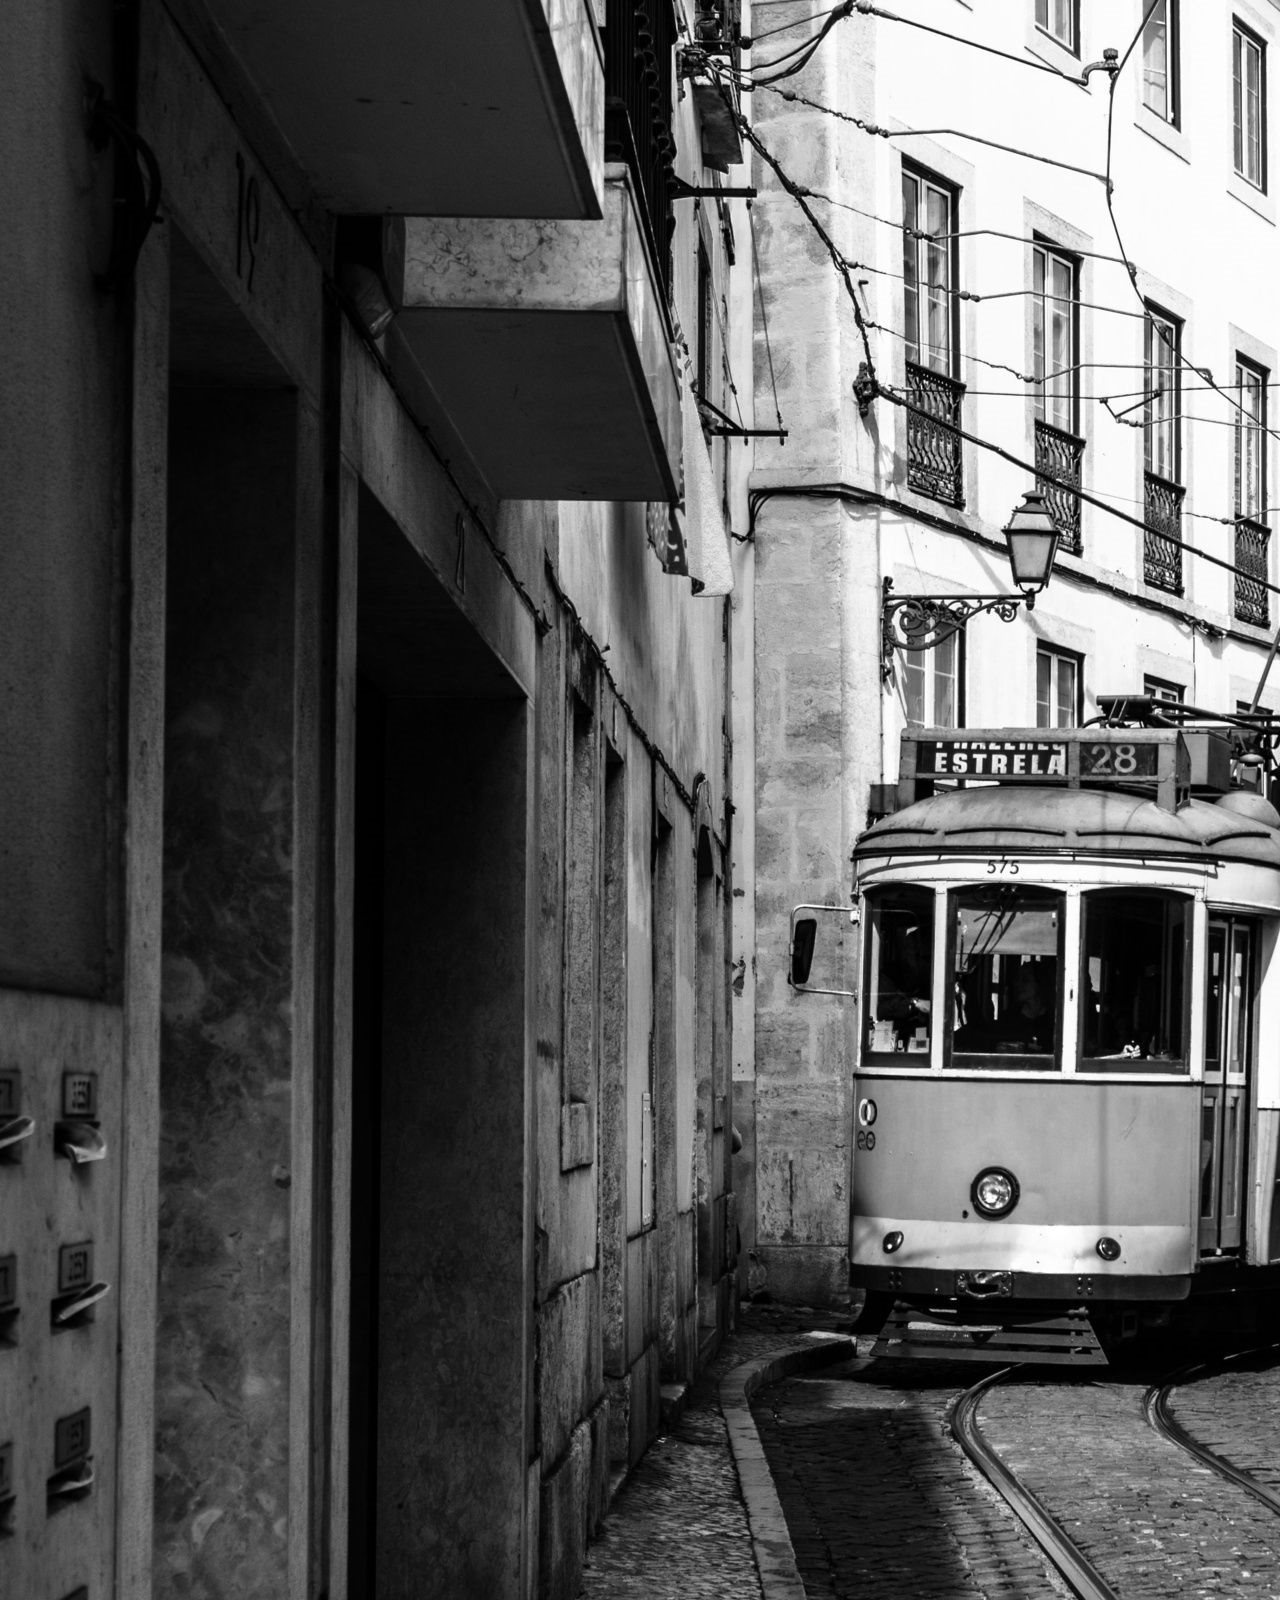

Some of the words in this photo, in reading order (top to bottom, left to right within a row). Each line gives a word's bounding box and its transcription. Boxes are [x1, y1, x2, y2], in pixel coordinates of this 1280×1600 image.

[235, 151, 261, 294] 19
[934, 752, 1065, 775] ESTRELA
[1091, 744, 1137, 773] 28
[987, 859, 1019, 875] 575
